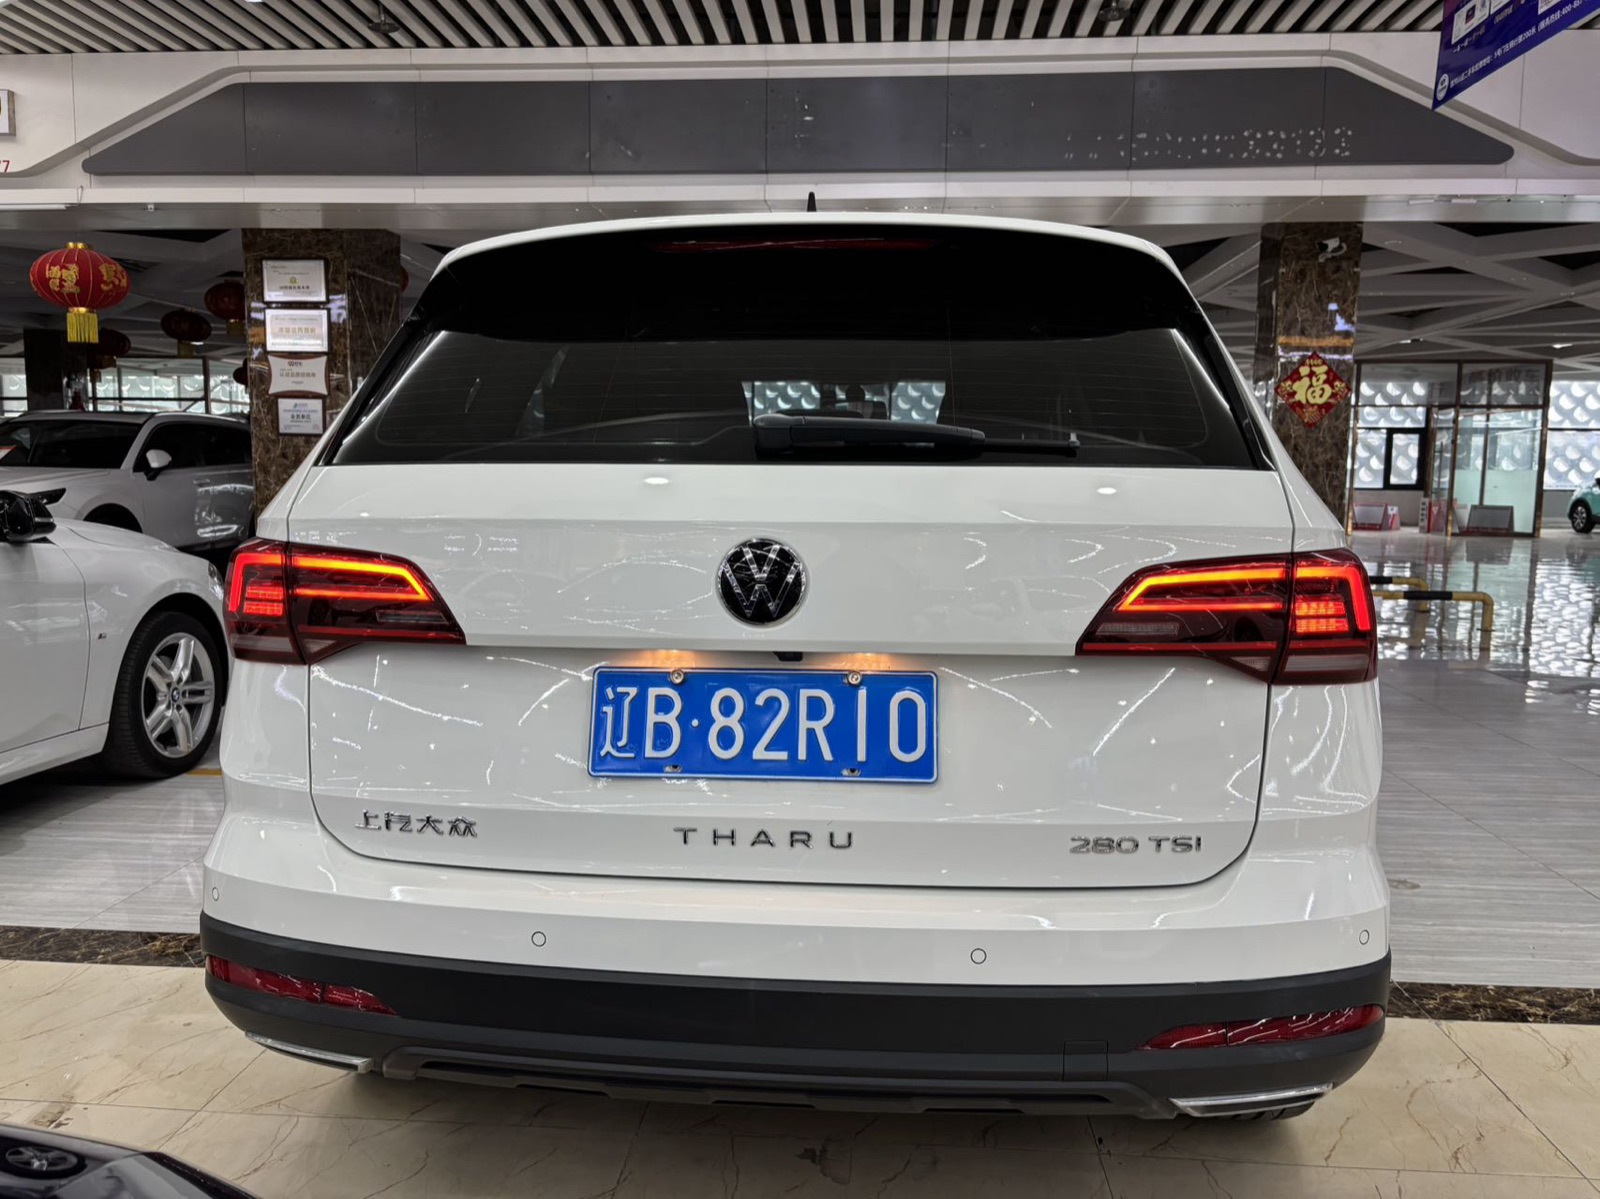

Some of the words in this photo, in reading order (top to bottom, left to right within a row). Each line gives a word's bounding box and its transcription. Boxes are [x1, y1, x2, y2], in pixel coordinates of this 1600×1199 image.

[1292, 364, 1332, 405] 福
[354, 808, 479, 839] 上汽大众
[672, 826, 854, 850] THARU
[1069, 835, 1140, 855] 280
[1147, 834, 1203, 854] TSI
